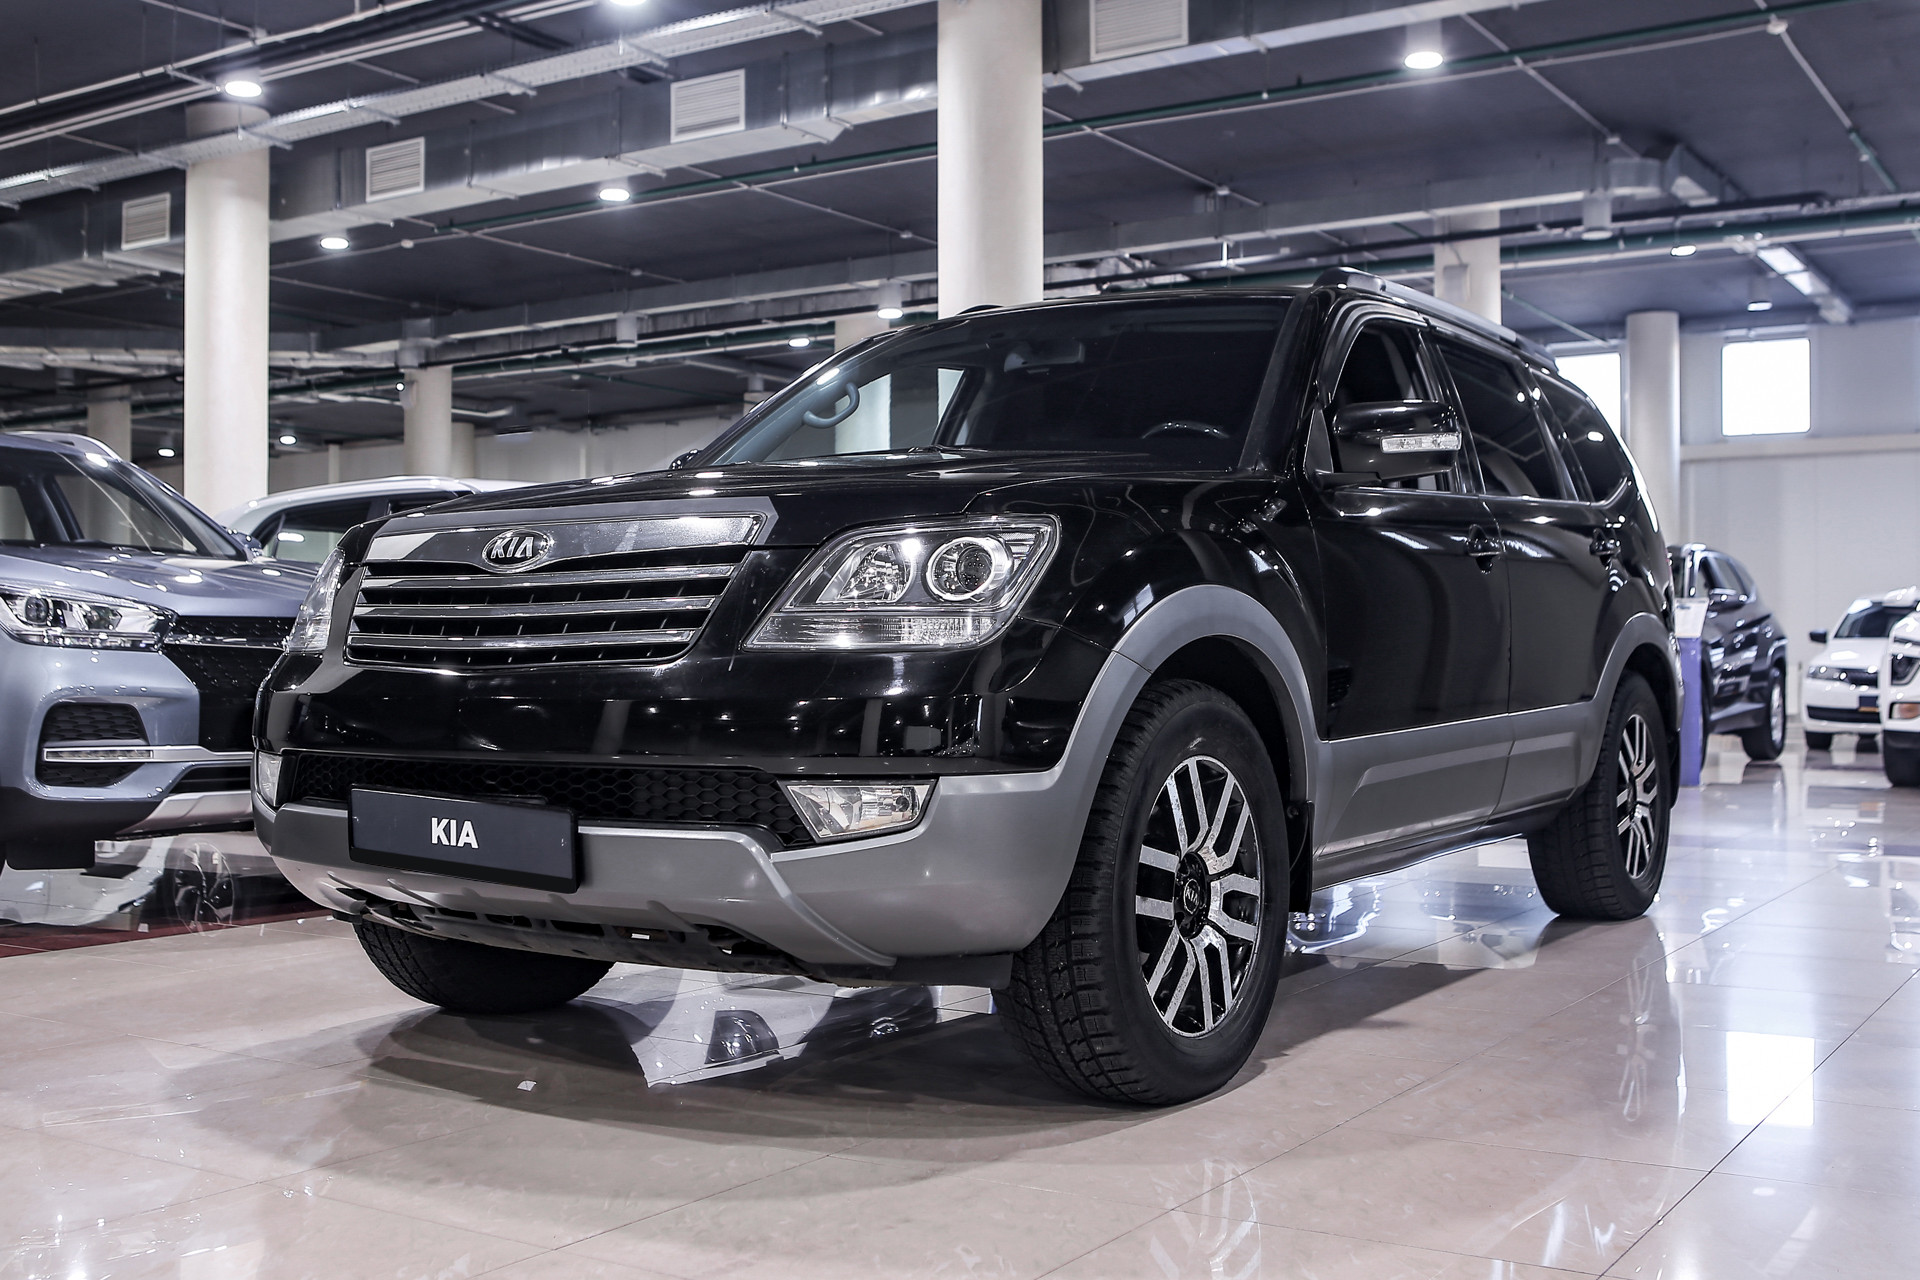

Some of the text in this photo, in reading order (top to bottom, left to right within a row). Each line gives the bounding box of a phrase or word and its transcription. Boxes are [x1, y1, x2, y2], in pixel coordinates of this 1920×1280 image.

[490, 536, 534, 559] KIA
[431, 817, 479, 848] KIA
[1185, 886, 1199, 905] KIA
